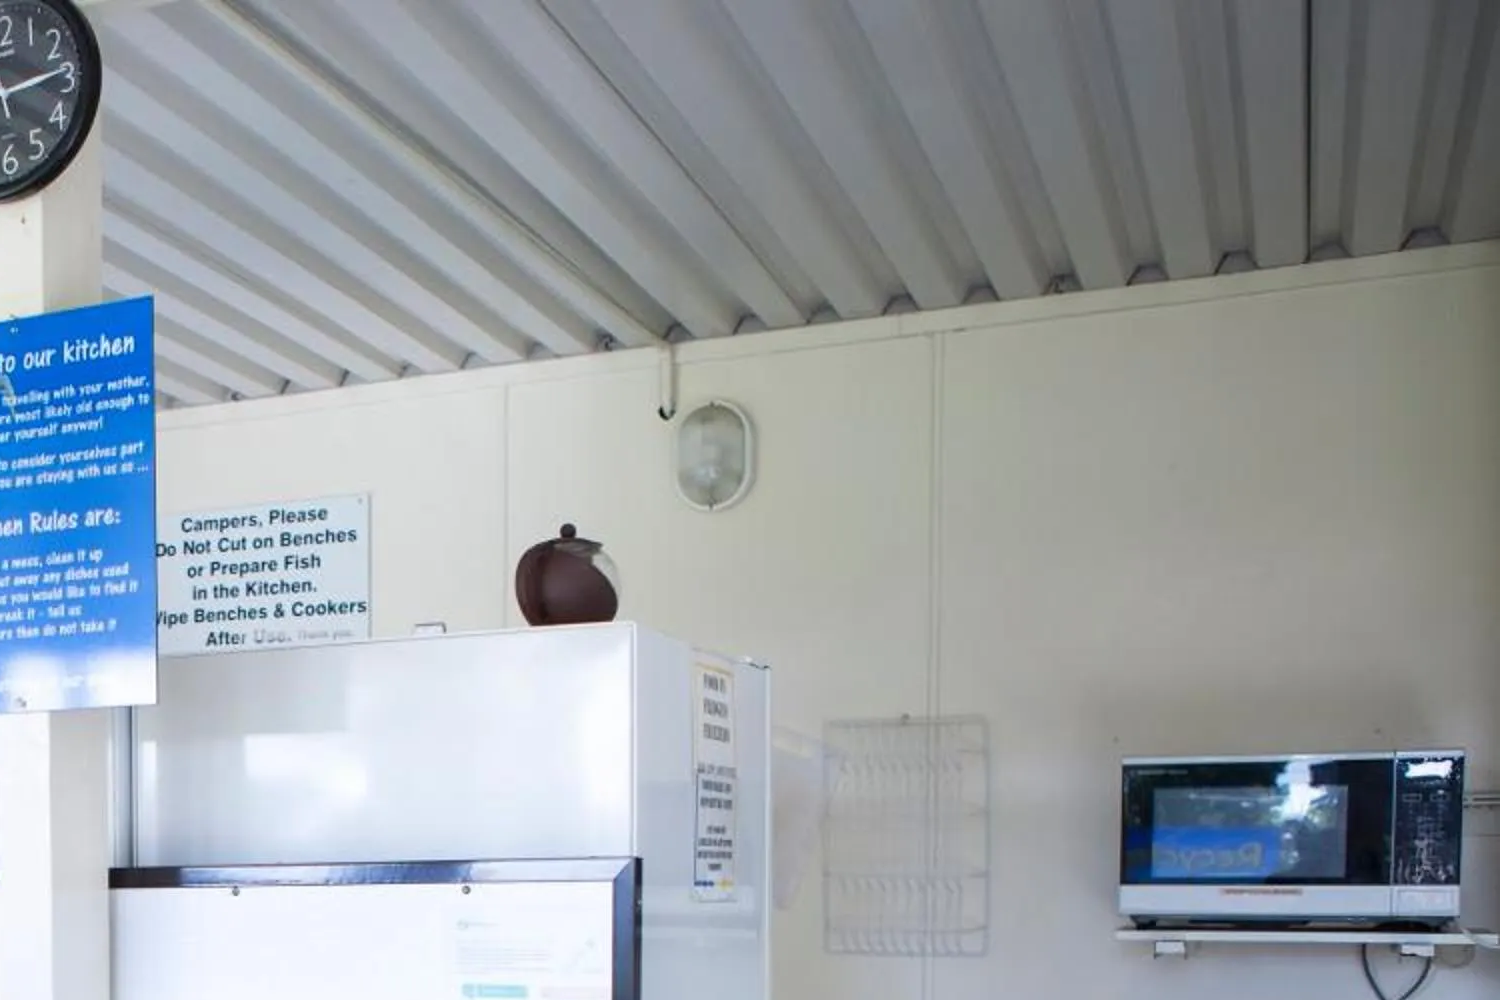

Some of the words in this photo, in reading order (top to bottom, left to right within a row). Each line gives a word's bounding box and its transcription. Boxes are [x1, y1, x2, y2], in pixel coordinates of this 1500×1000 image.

[27, 17, 33, 46] 1
[46, 29, 62, 61] 2
[59, 62, 75, 93] 3
[49, 101, 67, 130] 4
[28, 128, 45, 161] 5
[2, 144, 19, 175] 6
[23, 349, 57, 369] our
[62, 333, 136, 364] kitchen
[120, 440, 145, 460] part
[29, 511, 78, 534] Rules
[84, 506, 121, 526] are:
[180, 513, 263, 535] Campers,
[269, 507, 328, 525] Please
[156, 543, 176, 557] Do
[183, 540, 212, 556] Not
[217, 538, 247, 553] Cut
[253, 536, 274, 549] on
[280, 528, 358, 547] Benches
[187, 565, 203, 579] or
[210, 559, 279, 578] Prepare
[284, 553, 321, 570] Fish
[192, 586, 208, 601] in
[213, 584, 240, 599] the
[245, 578, 317, 597] Kitchen.
[156, 609, 188, 626] ipe
[194, 605, 268, 623] Benches
[273, 603, 285, 618] &
[291, 599, 368, 617] Cookers
[205, 631, 247, 647] After
